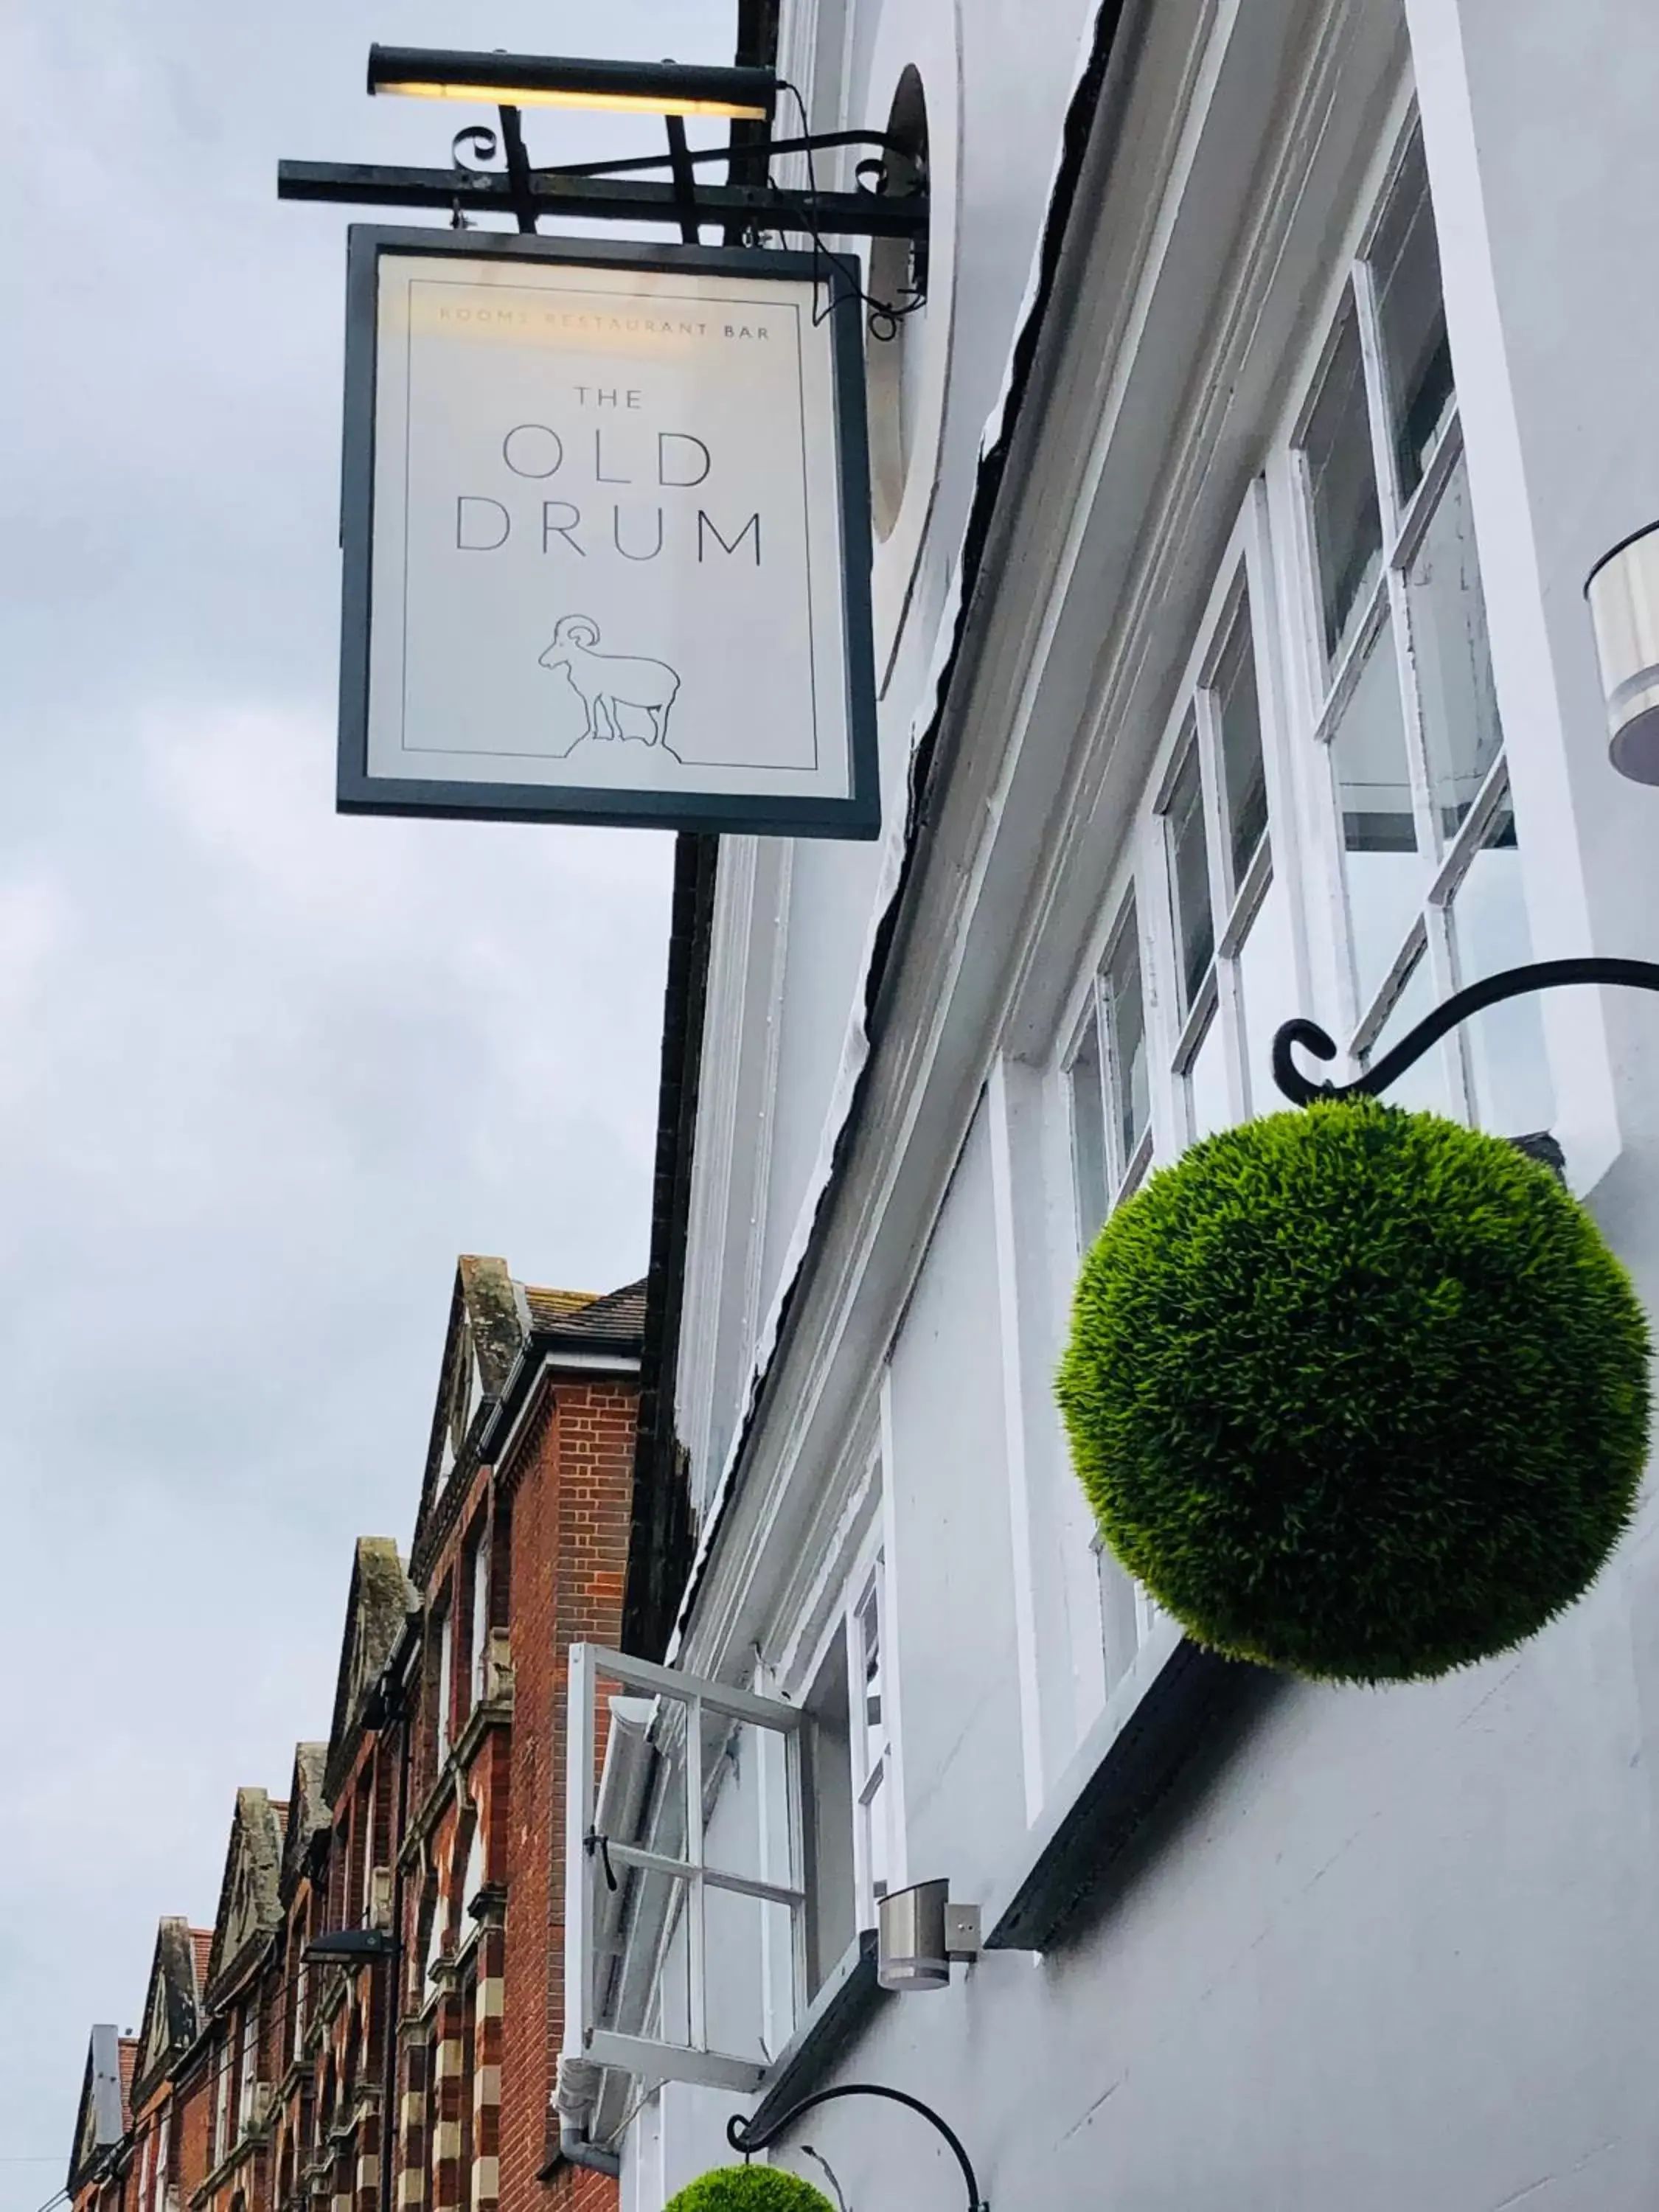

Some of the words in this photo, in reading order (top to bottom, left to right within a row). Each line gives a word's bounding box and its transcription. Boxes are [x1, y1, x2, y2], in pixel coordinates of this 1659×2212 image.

[439, 306, 529, 324] ROOMS
[545, 312, 708, 335] RESTAURANT
[723, 324, 770, 340] BAR
[573, 386, 643, 408] THE
[502, 423, 711, 487] OLD
[456, 495, 761, 567] DRUM
